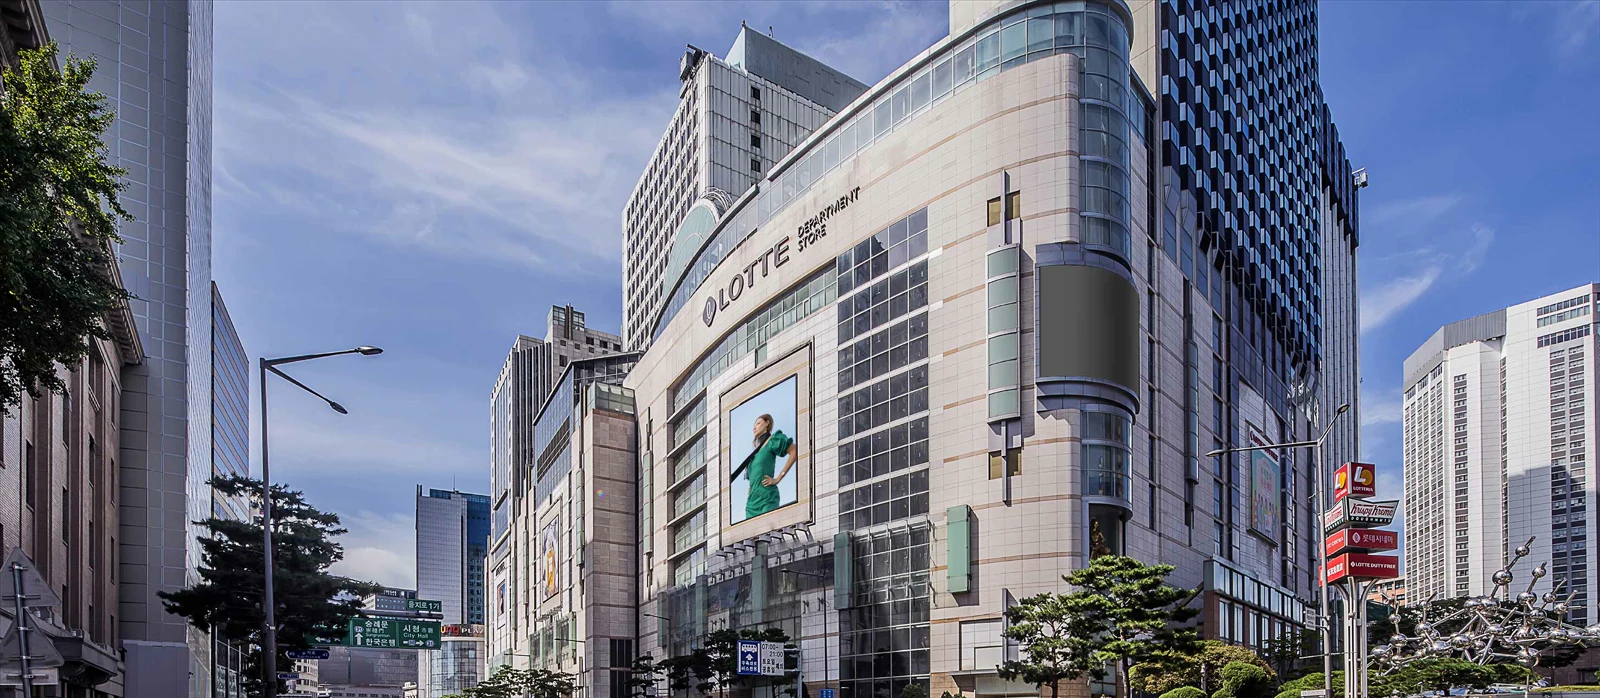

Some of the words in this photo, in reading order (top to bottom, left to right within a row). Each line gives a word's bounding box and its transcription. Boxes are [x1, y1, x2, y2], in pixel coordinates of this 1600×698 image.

[797, 186, 861, 238] DEPARTMENT
[797, 224, 827, 252] STORE
[718, 235, 790, 311] LOTTE
[1371, 504, 1395, 517] Kreme
[1362, 534, 1394, 544] 롯데시네마
[365, 620, 389, 629] 숭례문
[403, 624, 420, 633] 시청
[440, 624, 460, 637] ung
[365, 638, 396, 647] 한국은행
